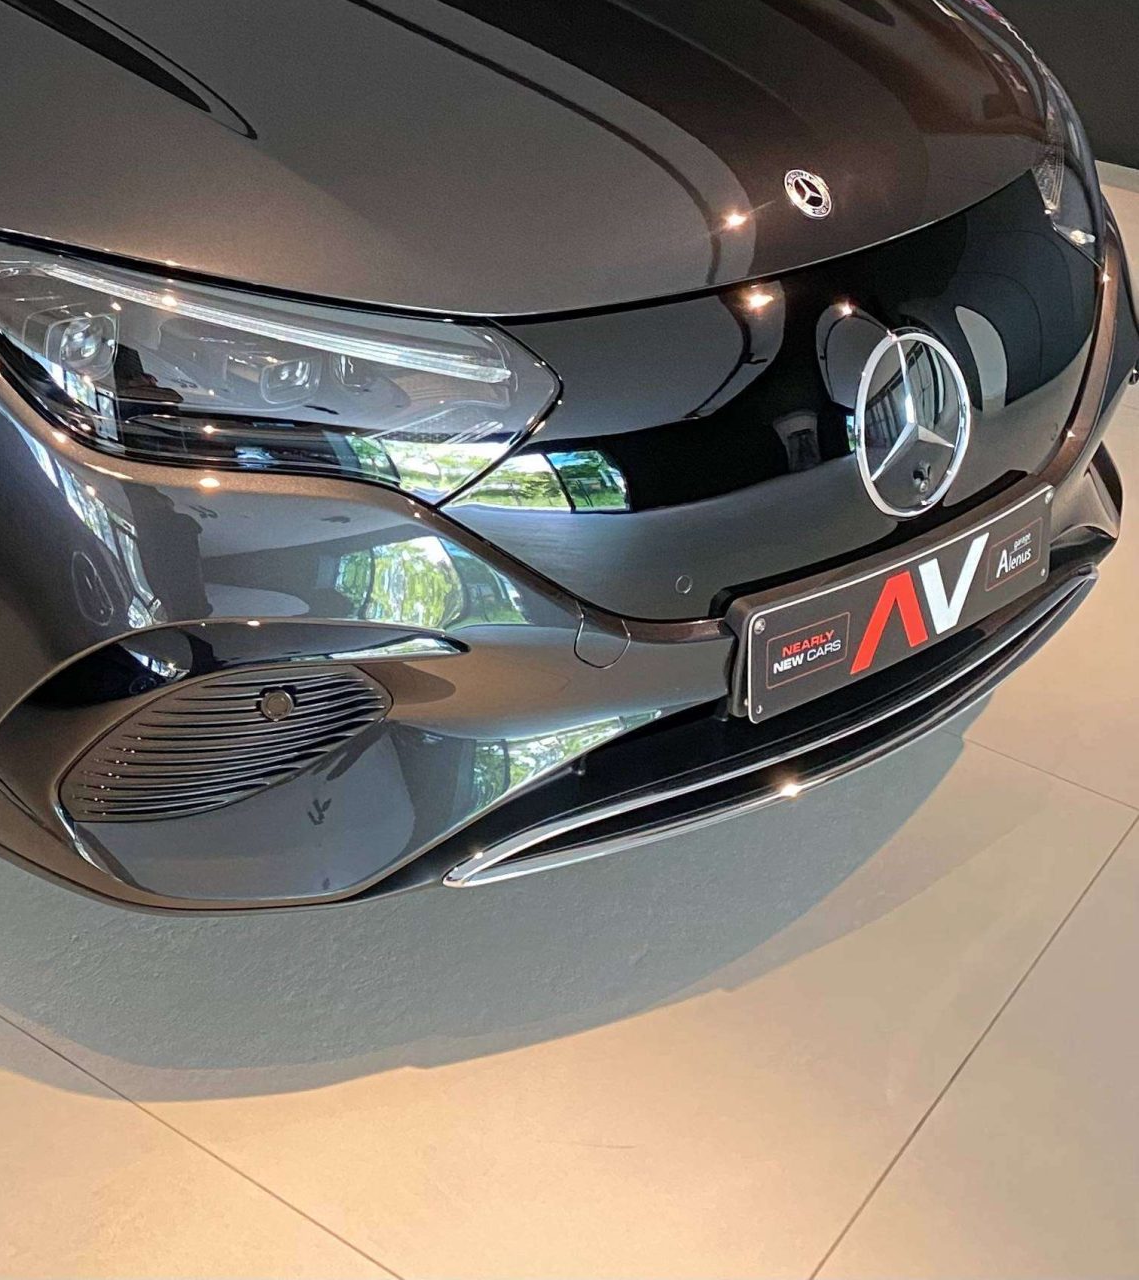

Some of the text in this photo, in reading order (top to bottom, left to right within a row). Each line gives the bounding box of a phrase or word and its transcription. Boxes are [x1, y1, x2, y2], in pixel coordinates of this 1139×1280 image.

[996, 548, 1032, 578] Alenus
[773, 639, 842, 675] NEW CARS
[782, 629, 835, 658] NEARLY
